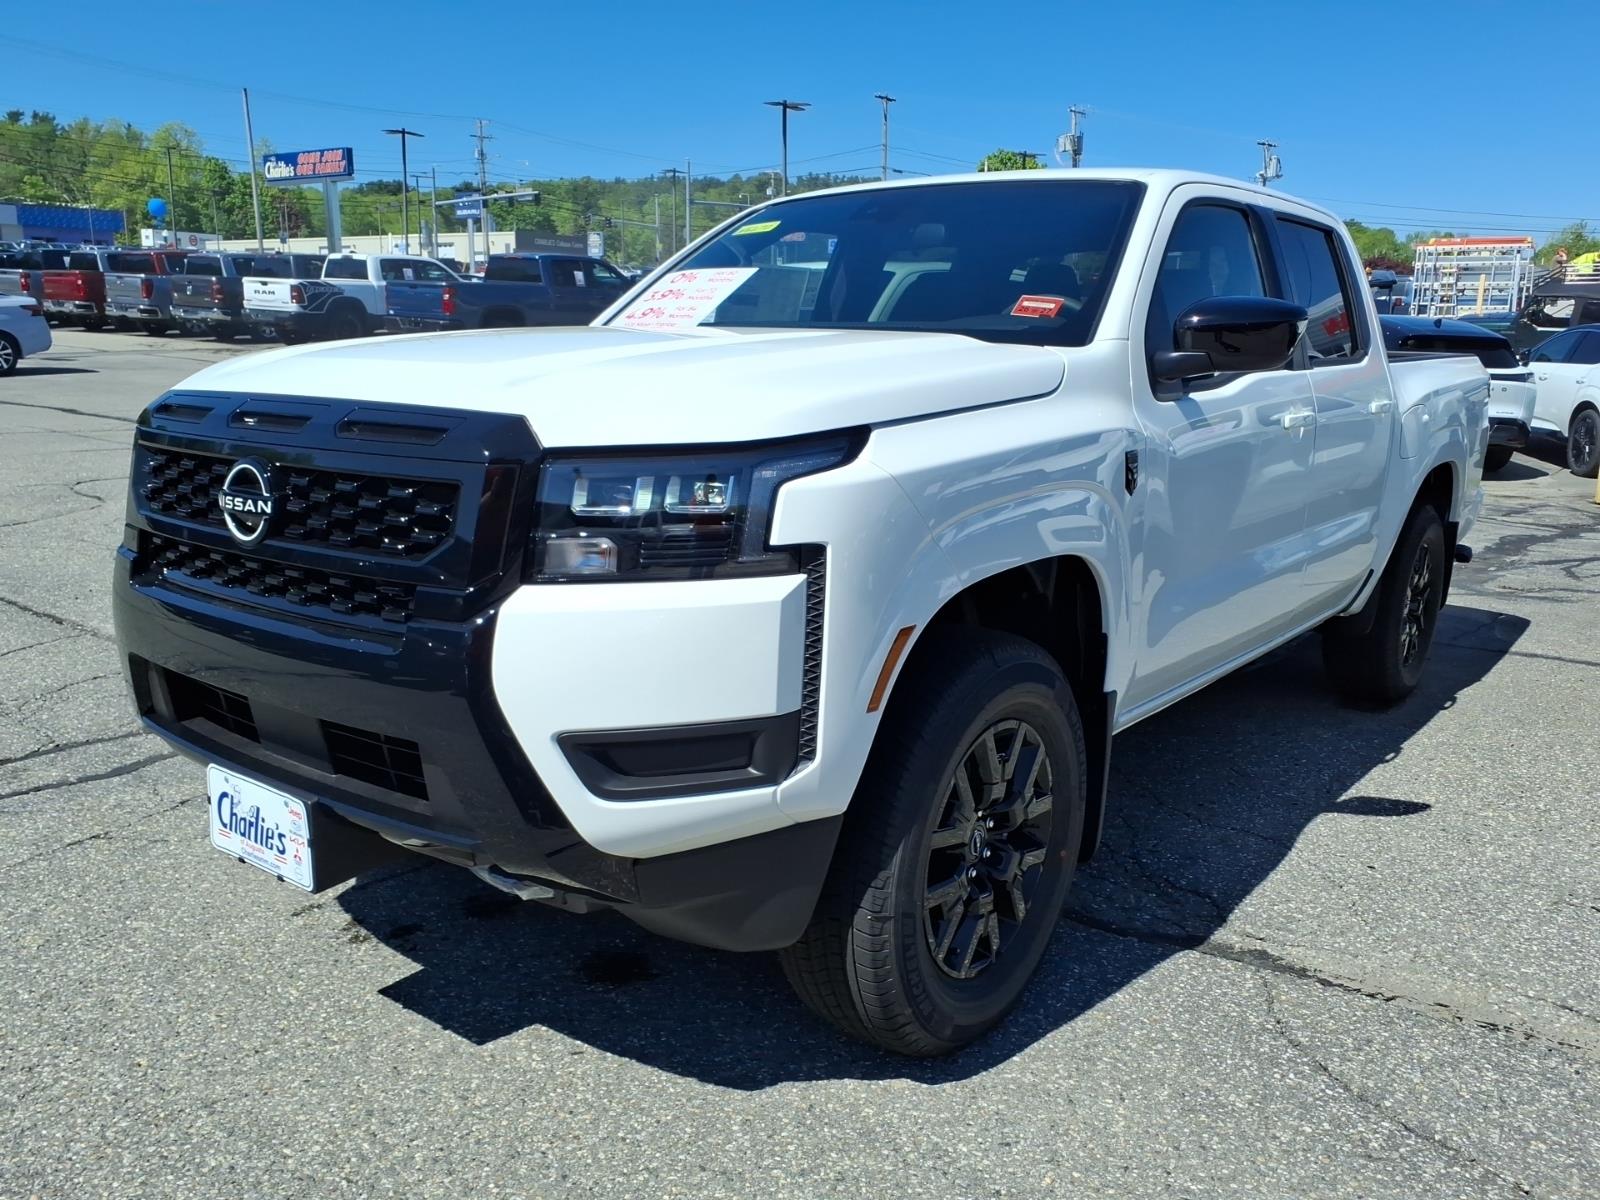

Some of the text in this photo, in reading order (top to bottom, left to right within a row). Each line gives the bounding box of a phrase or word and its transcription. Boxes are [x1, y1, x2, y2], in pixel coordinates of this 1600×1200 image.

[297, 149, 343, 165] COME JOIN
[265, 160, 294, 178] Charlie's
[296, 160, 346, 176] OUR FAMILY
[671, 271, 698, 284] 0%
[218, 491, 272, 514] NISSAN
[217, 791, 287, 856] Charlie's
